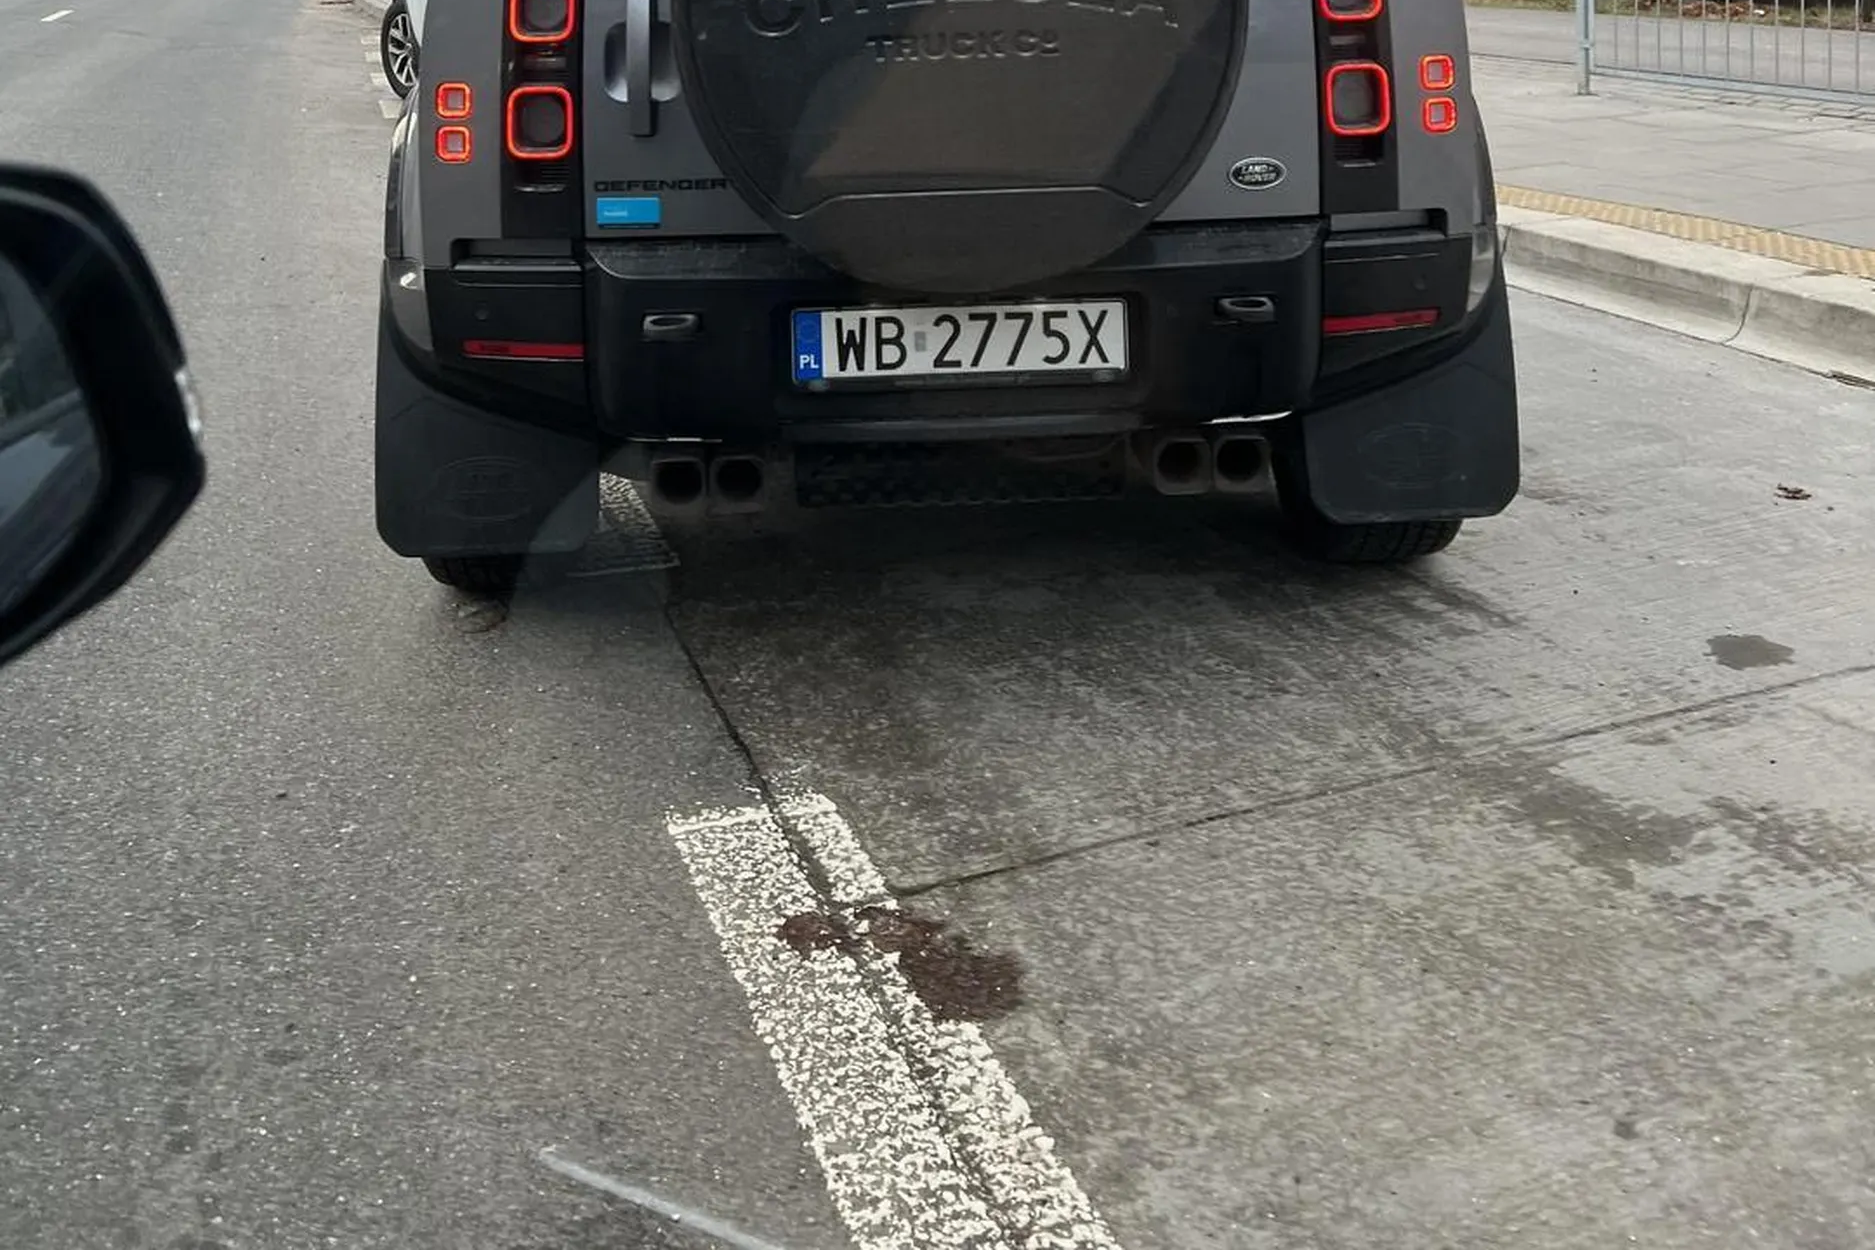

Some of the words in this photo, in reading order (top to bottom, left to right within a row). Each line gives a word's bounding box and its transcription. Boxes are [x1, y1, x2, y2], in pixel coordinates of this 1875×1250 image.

[866, 30, 1007, 62] TRUCK
[594, 178, 729, 192] DEFENDER
[834, 315, 908, 372] WB
[931, 308, 1110, 369] 2775X
[799, 354, 819, 370] PL
